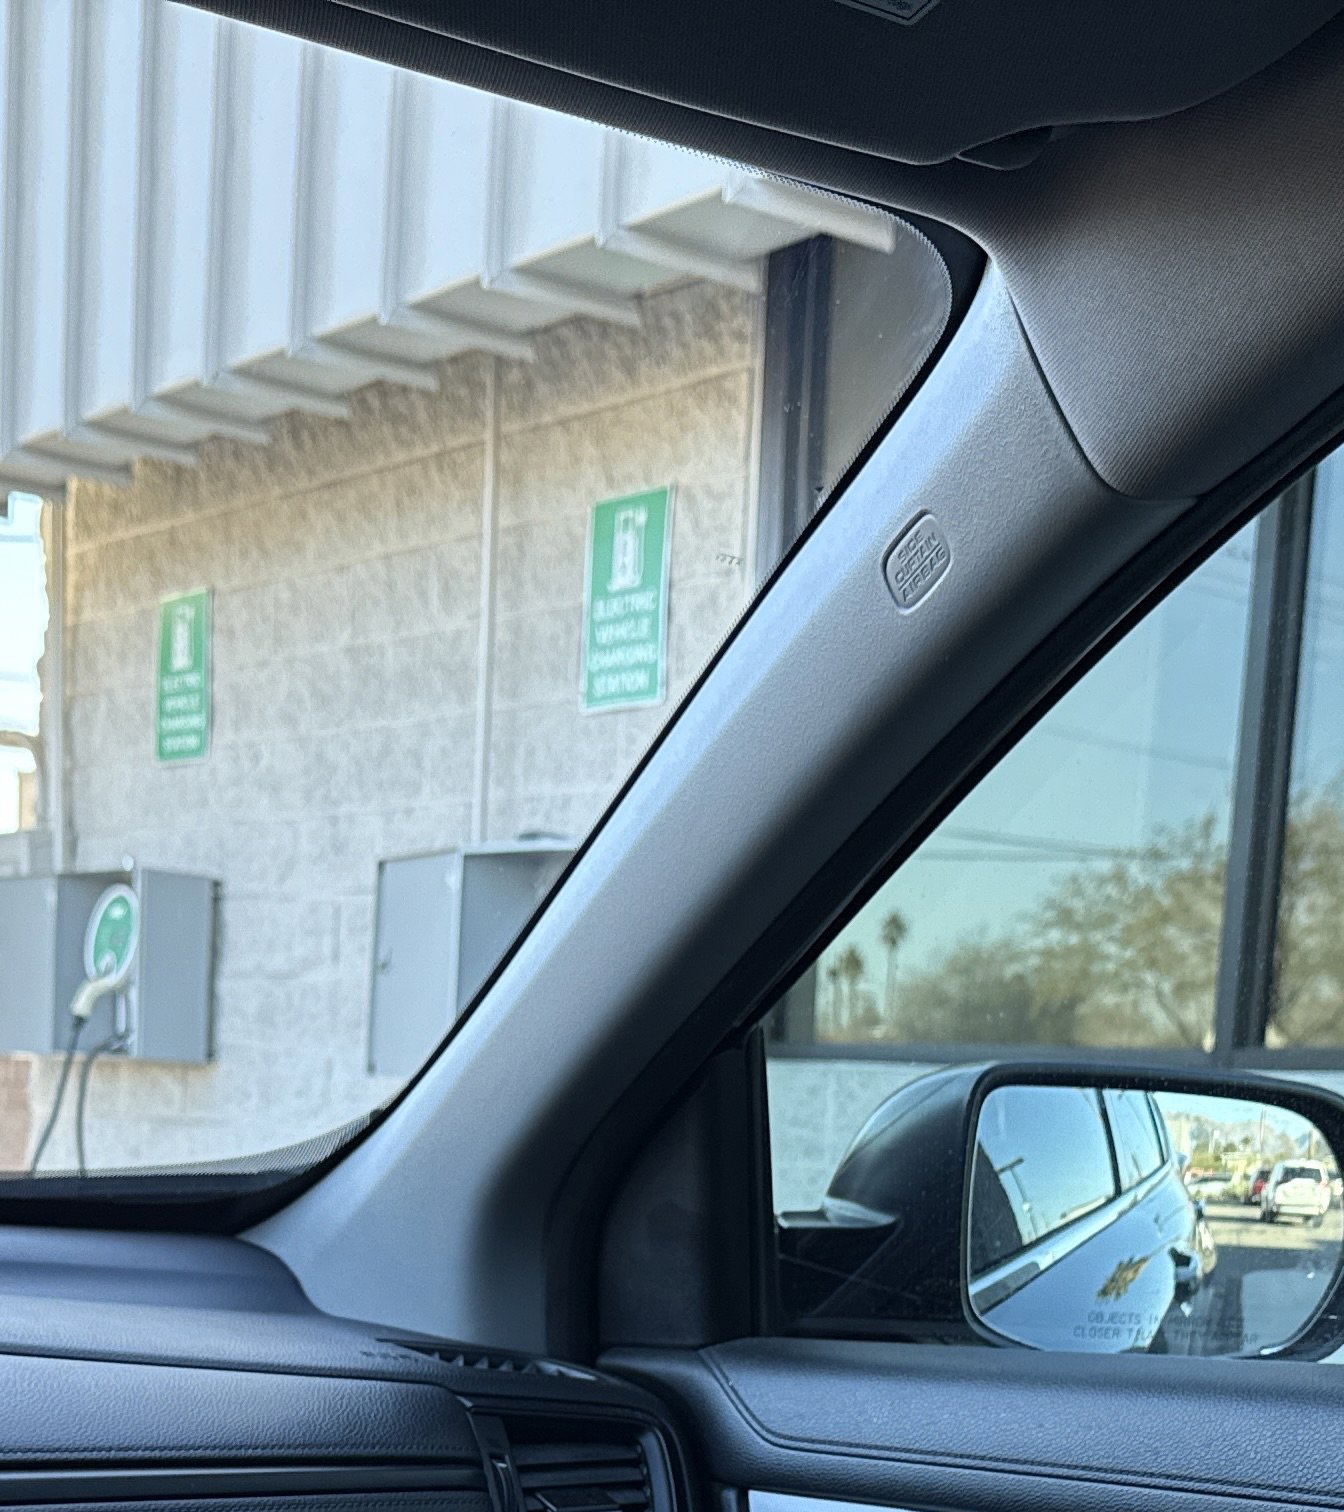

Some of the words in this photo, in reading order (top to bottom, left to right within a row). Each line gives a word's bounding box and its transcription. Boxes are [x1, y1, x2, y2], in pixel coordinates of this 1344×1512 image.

[897, 530, 923, 562] SIDE
[1087, 1311, 1141, 1325] OBJECTS
[1073, 1325, 1120, 1339] CLOSER
